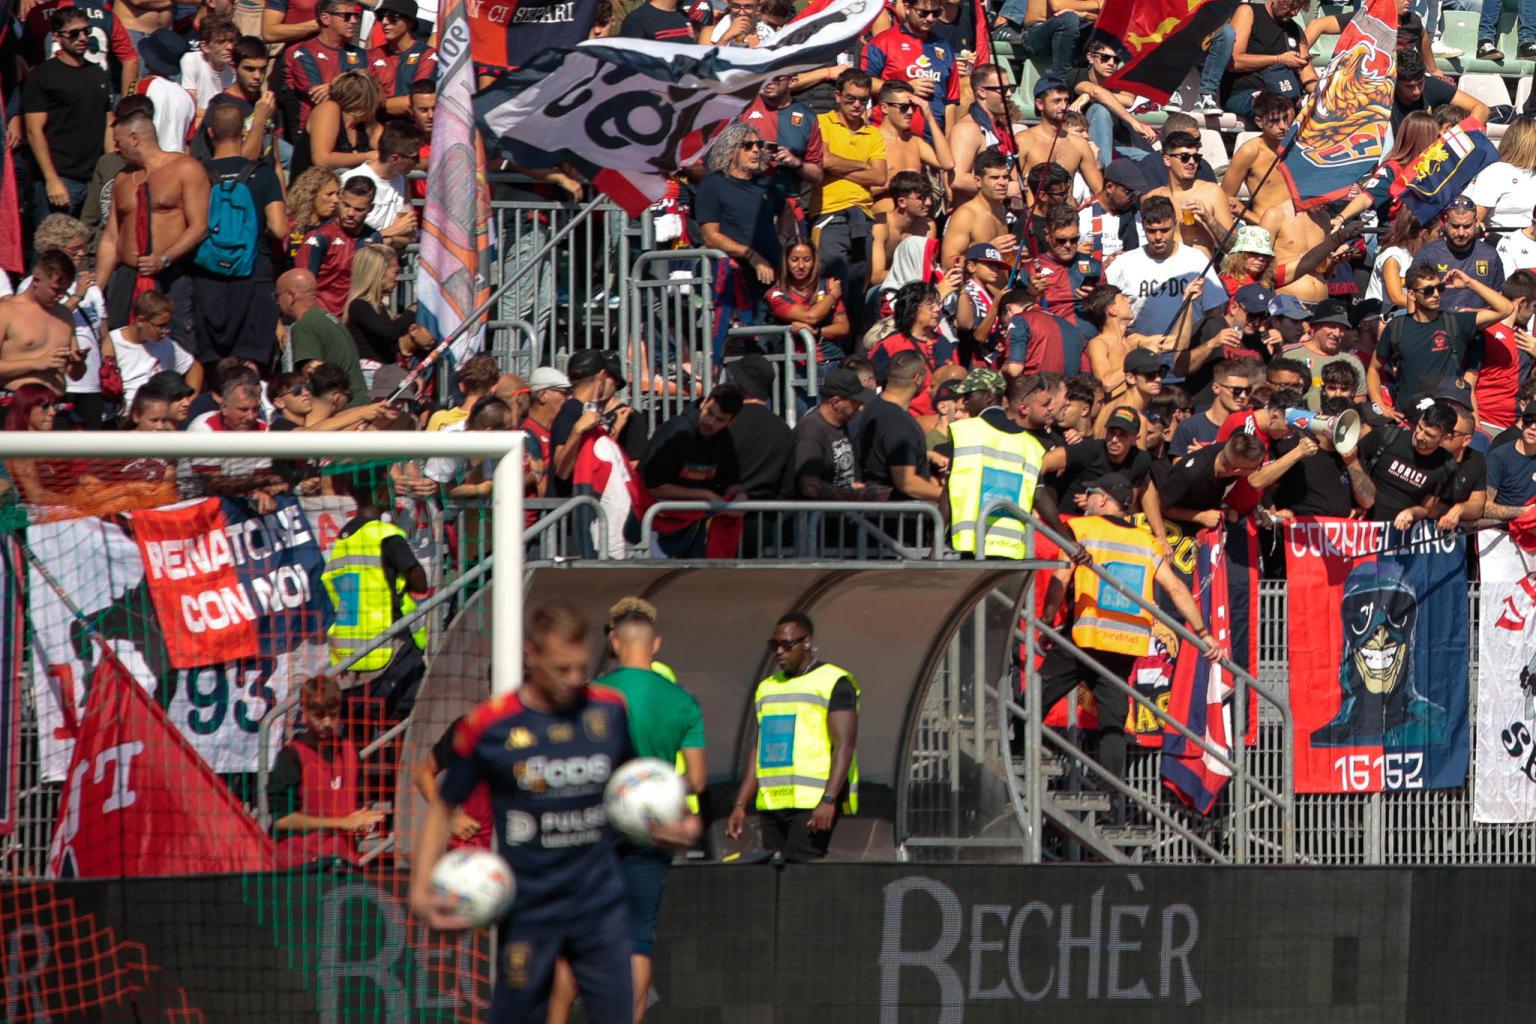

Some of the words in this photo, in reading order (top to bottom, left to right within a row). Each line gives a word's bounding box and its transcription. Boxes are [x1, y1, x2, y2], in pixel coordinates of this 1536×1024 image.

[487, 4, 510, 23] CI
[512, 2, 574, 23] SEPARI
[906, 64, 941, 82] Costa
[180, 582, 256, 633] CON
[253, 564, 312, 616] NOI
[1334, 752, 1423, 790] 16152
